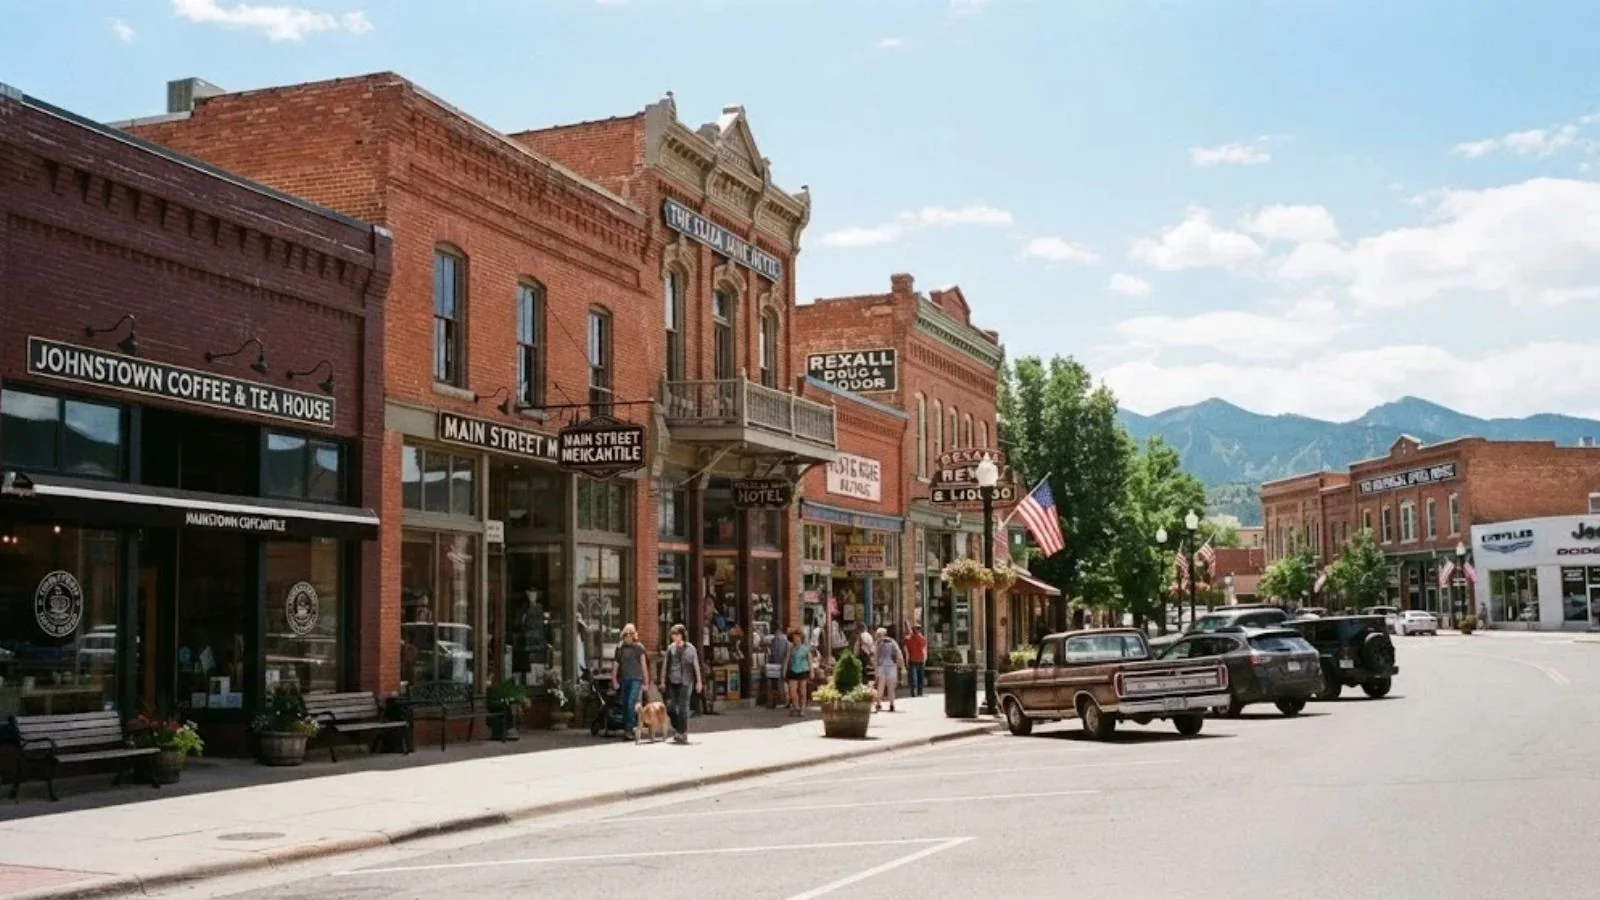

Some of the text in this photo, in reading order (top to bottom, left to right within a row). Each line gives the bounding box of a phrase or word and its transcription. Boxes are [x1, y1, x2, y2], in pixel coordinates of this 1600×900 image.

[810, 351, 893, 370] REXALL
[36, 345, 331, 421] JOHNSTOWN COFFEE & TEA HOUSE
[445, 416, 485, 444] MAIN
[490, 426, 544, 456] STREET
[595, 431, 640, 446] STREET
